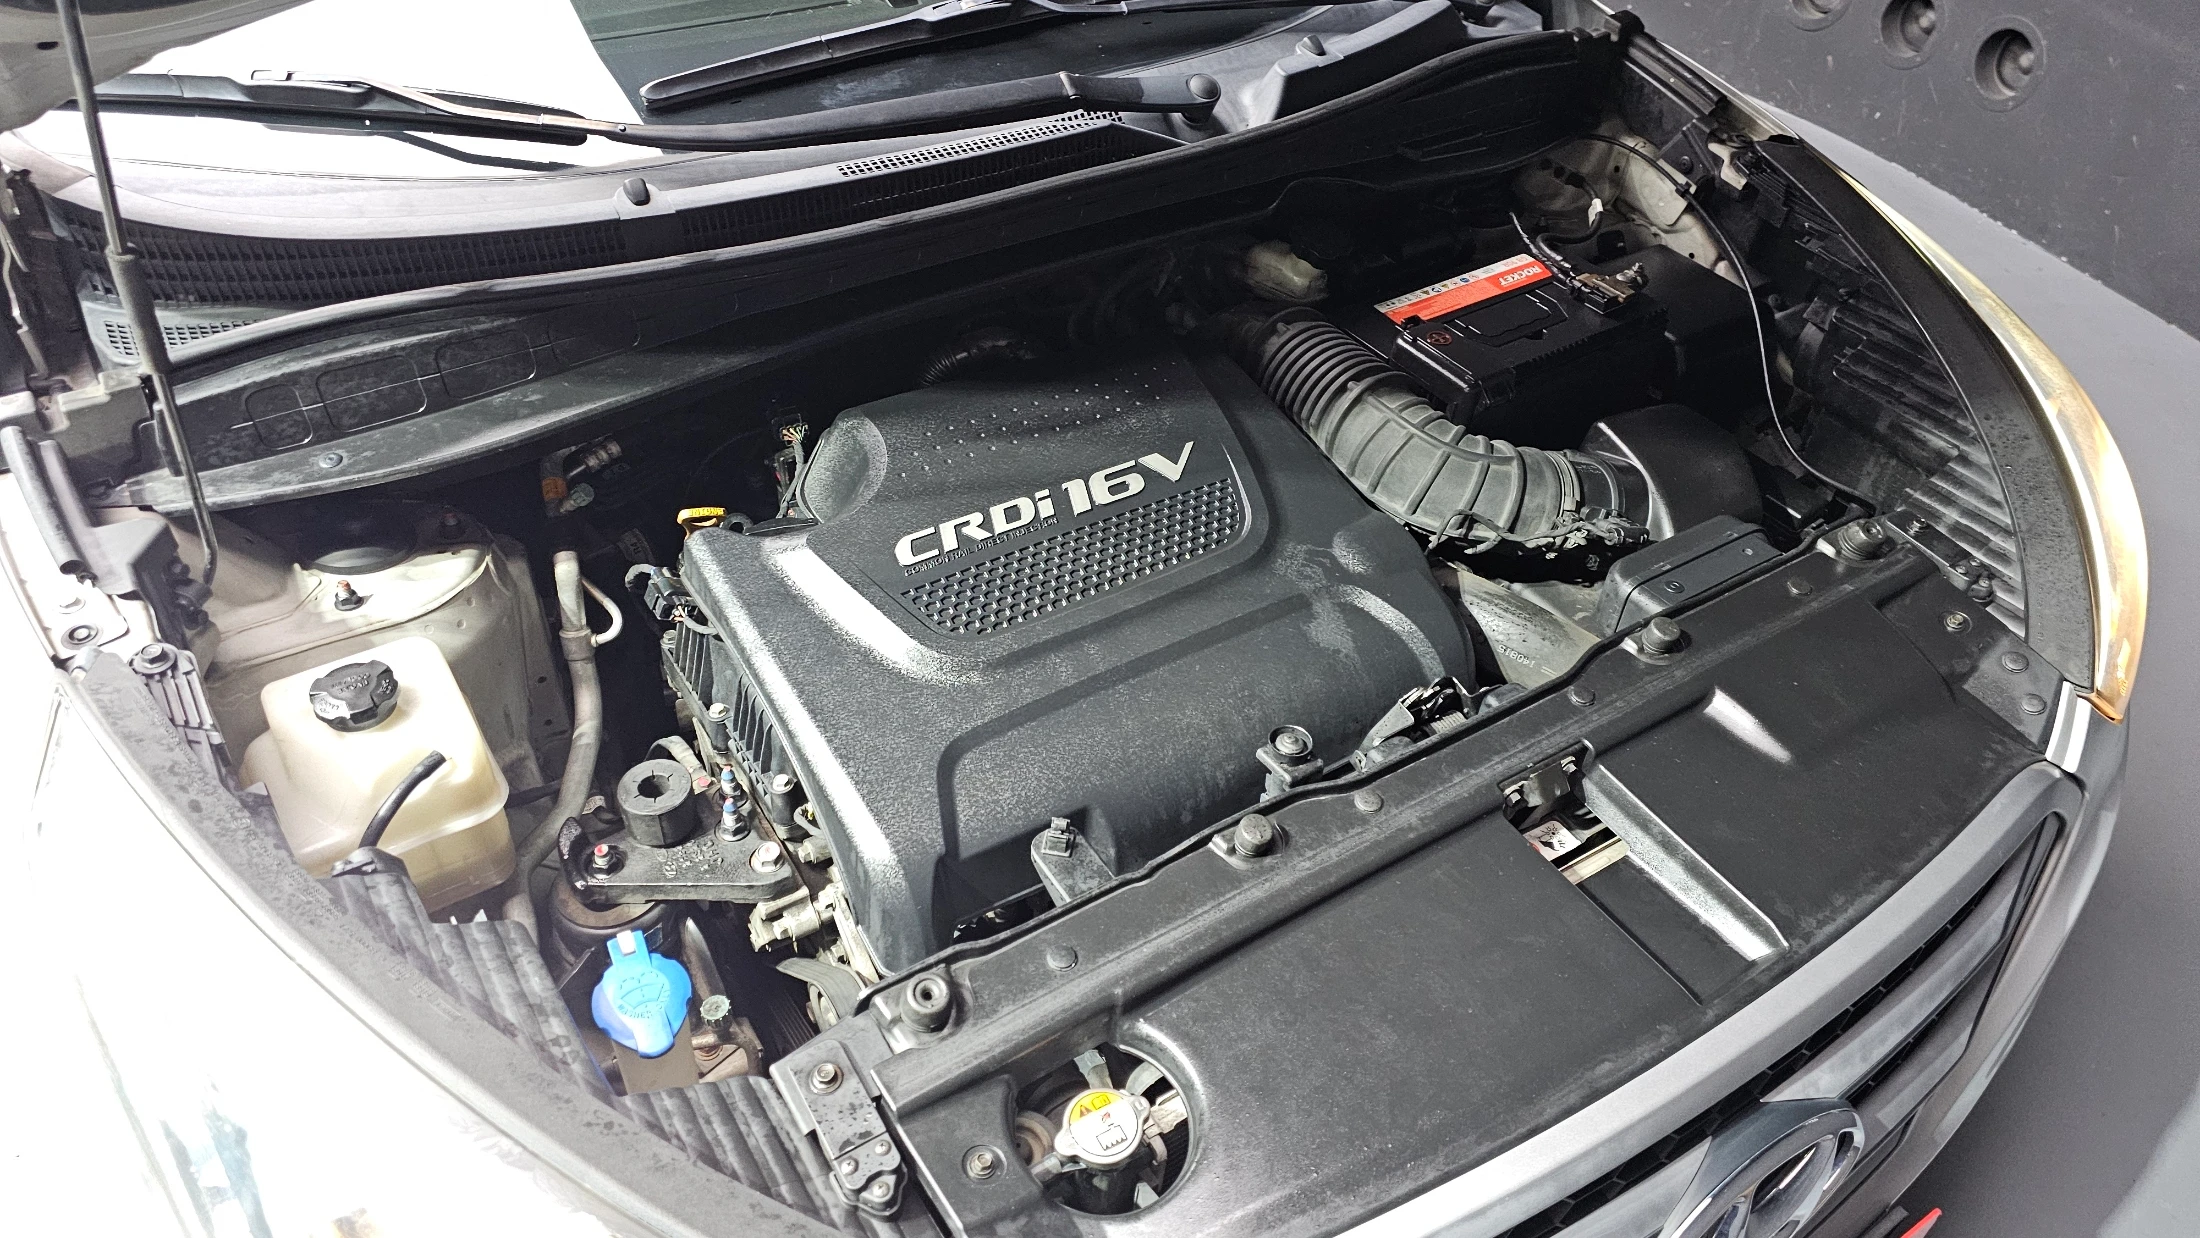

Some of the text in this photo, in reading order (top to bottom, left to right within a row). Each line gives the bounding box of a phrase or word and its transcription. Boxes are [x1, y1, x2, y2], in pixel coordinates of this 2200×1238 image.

[1499, 265, 1543, 286] ROCKET
[894, 440, 1195, 568] CRDi 16V
[951, 547, 975, 561] RAIL
[975, 534, 1011, 552] DIRECT
[1497, 644, 1536, 668] 140815
